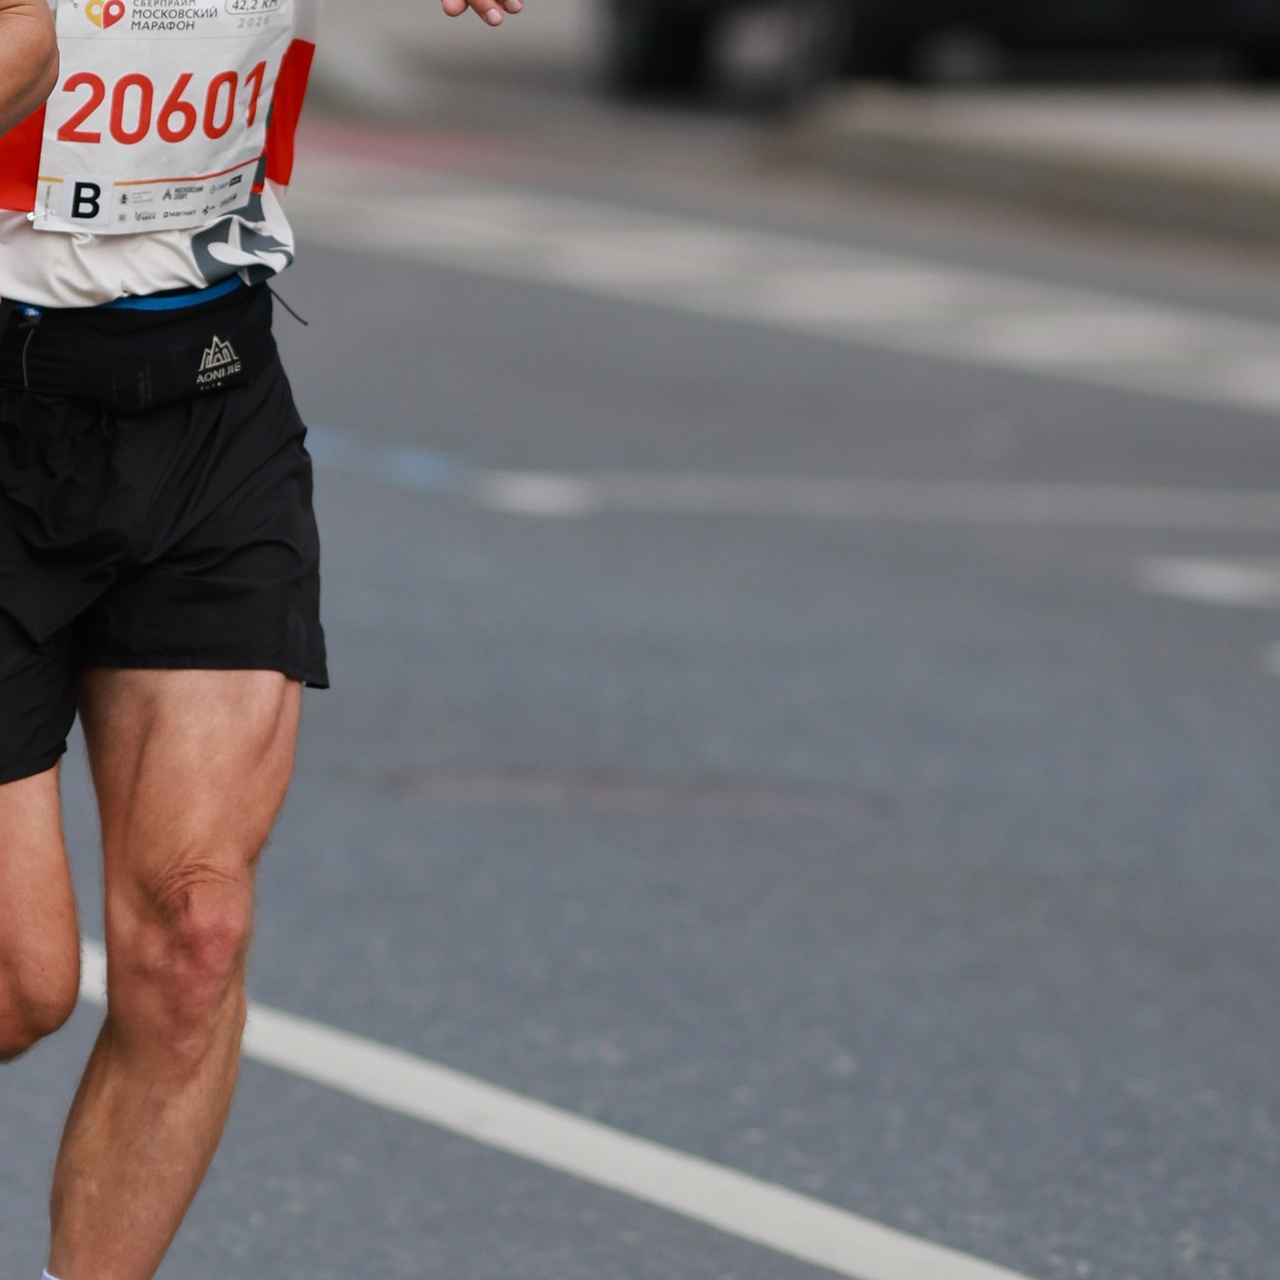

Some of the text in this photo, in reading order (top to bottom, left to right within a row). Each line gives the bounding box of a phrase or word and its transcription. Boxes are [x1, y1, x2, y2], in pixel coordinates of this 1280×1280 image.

[131, 7, 218, 19] МОСКОВСКИЙ
[231, 0, 258, 11] 42,2
[131, 21, 195, 31] МАРАФОН
[56, 60, 268, 145] 20601
[71, 181, 102, 219] B
[196, 361, 241, 384] AONIJIE
